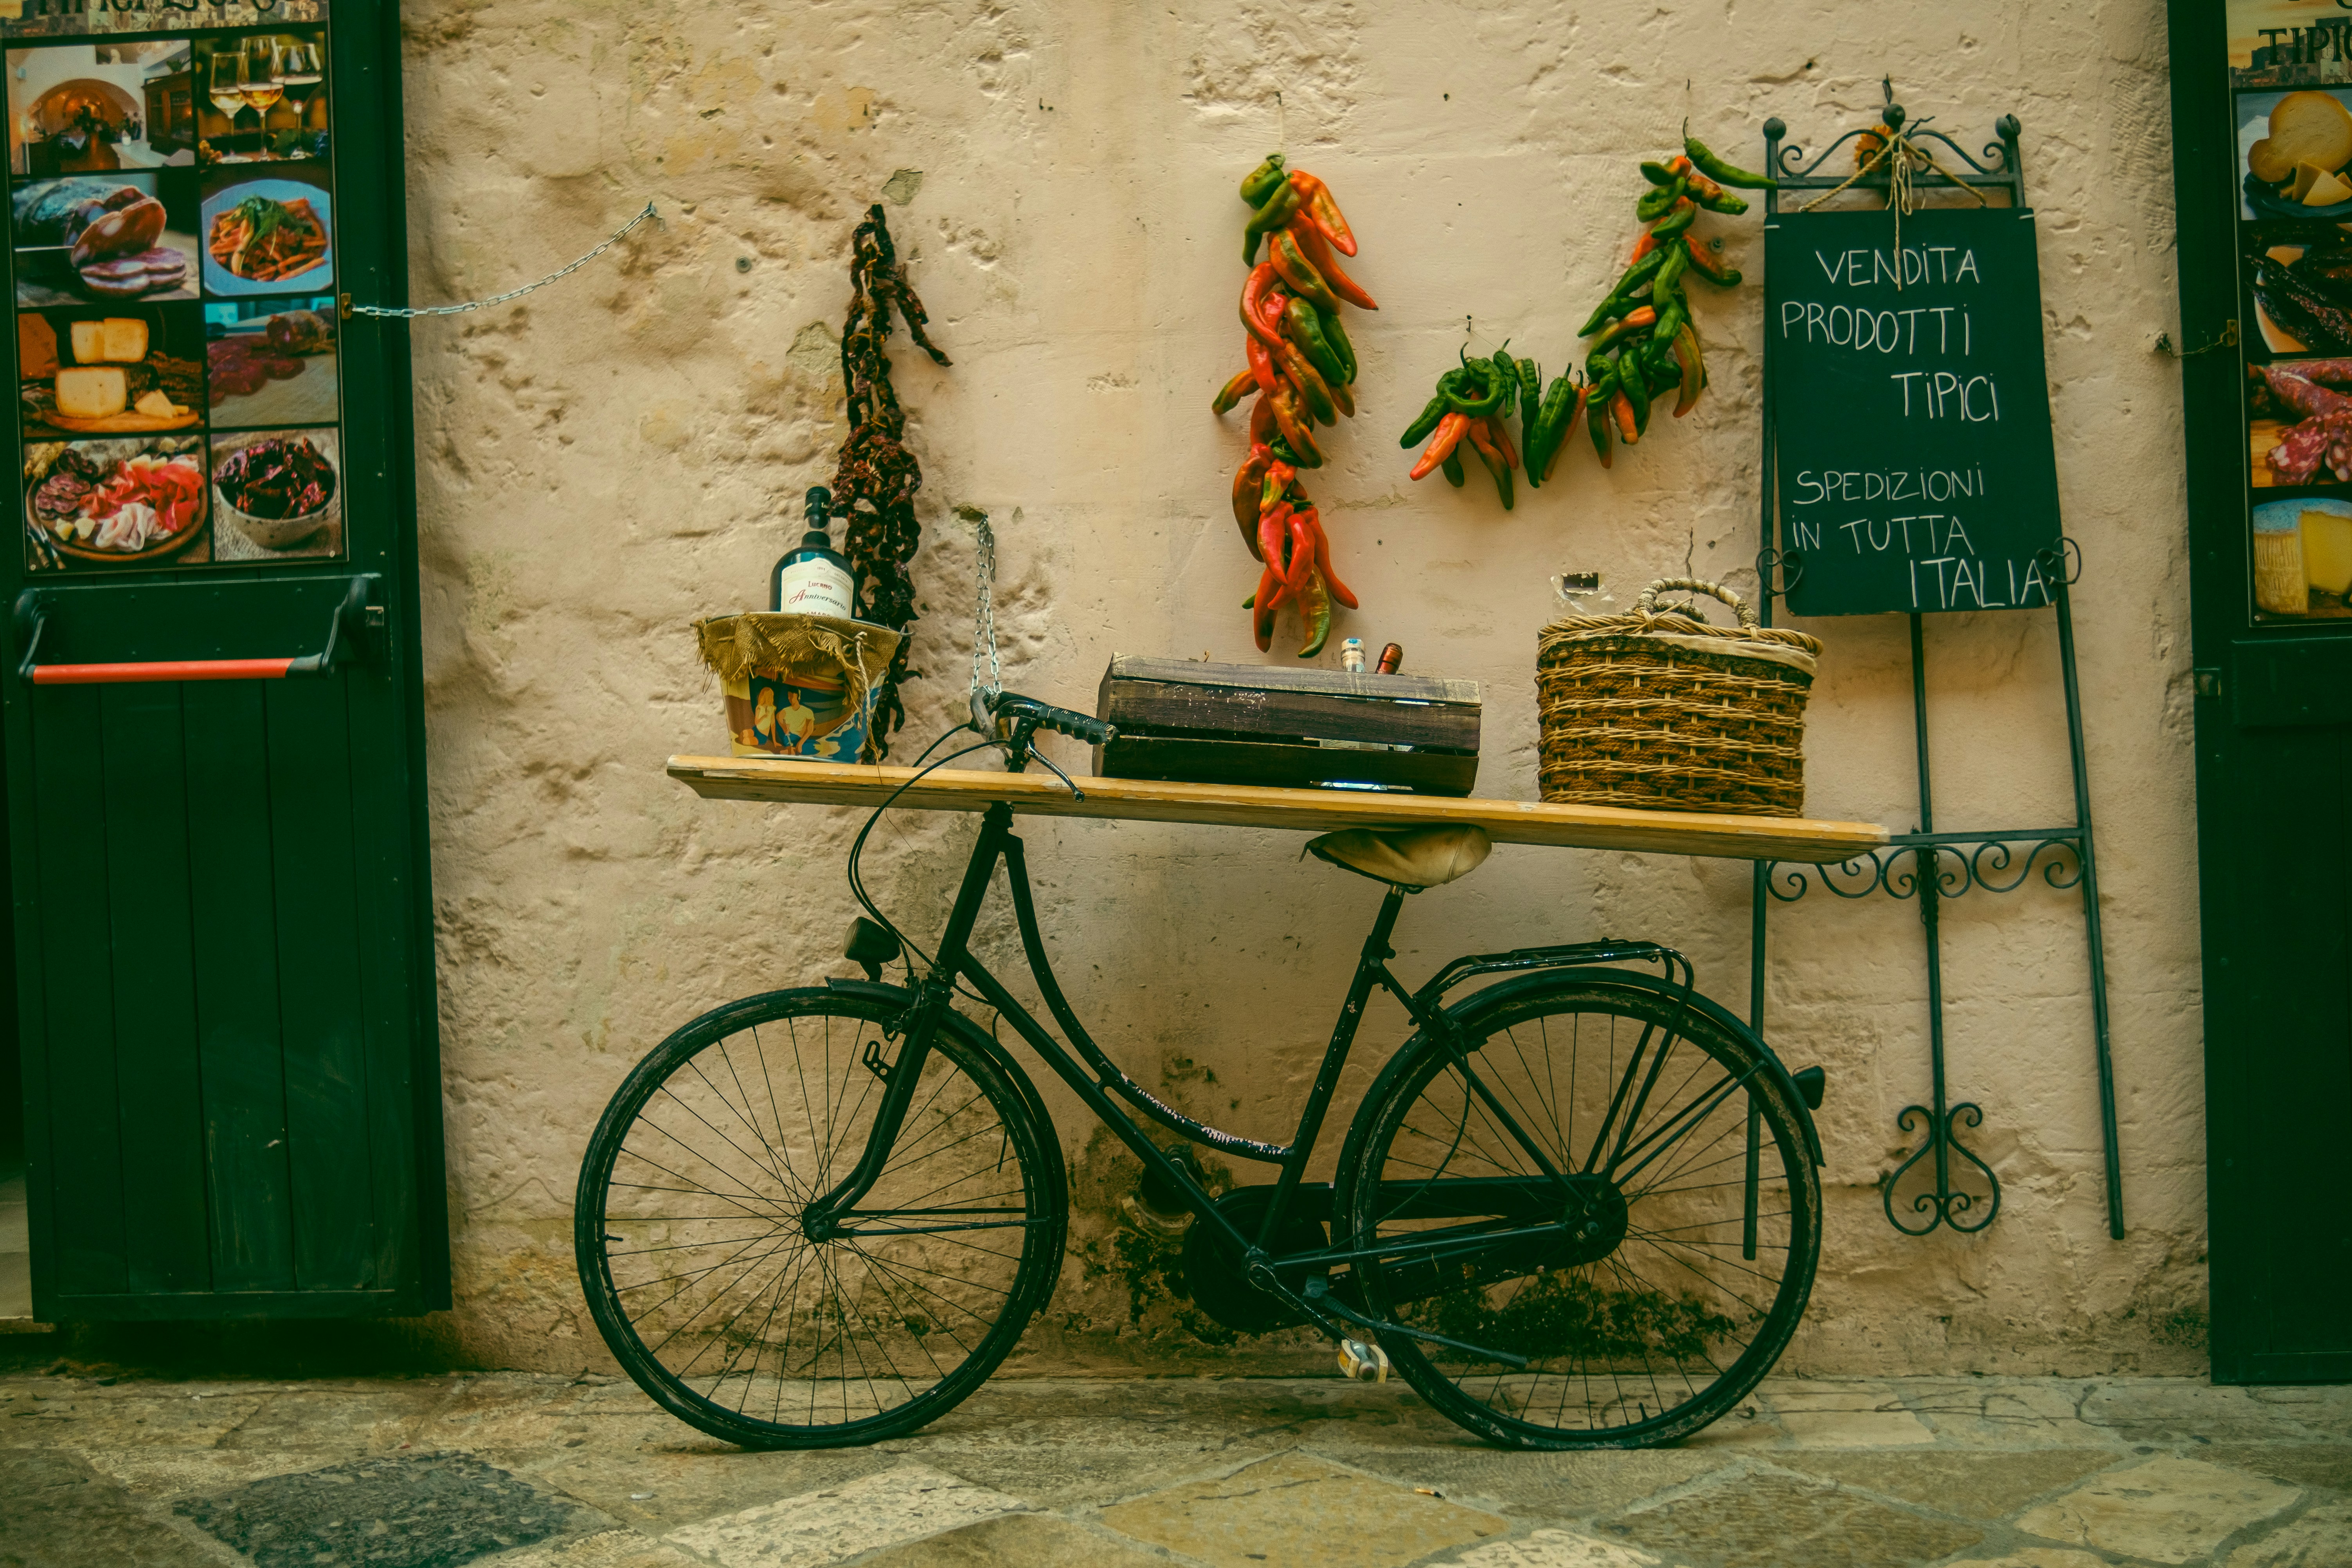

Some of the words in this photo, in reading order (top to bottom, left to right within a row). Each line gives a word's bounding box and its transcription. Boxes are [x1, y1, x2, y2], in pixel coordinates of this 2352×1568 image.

[1839, 515, 1975, 555] TUTTA
[789, 589, 846, 610] Anniversario
[1910, 557, 2050, 608] ITALIA
